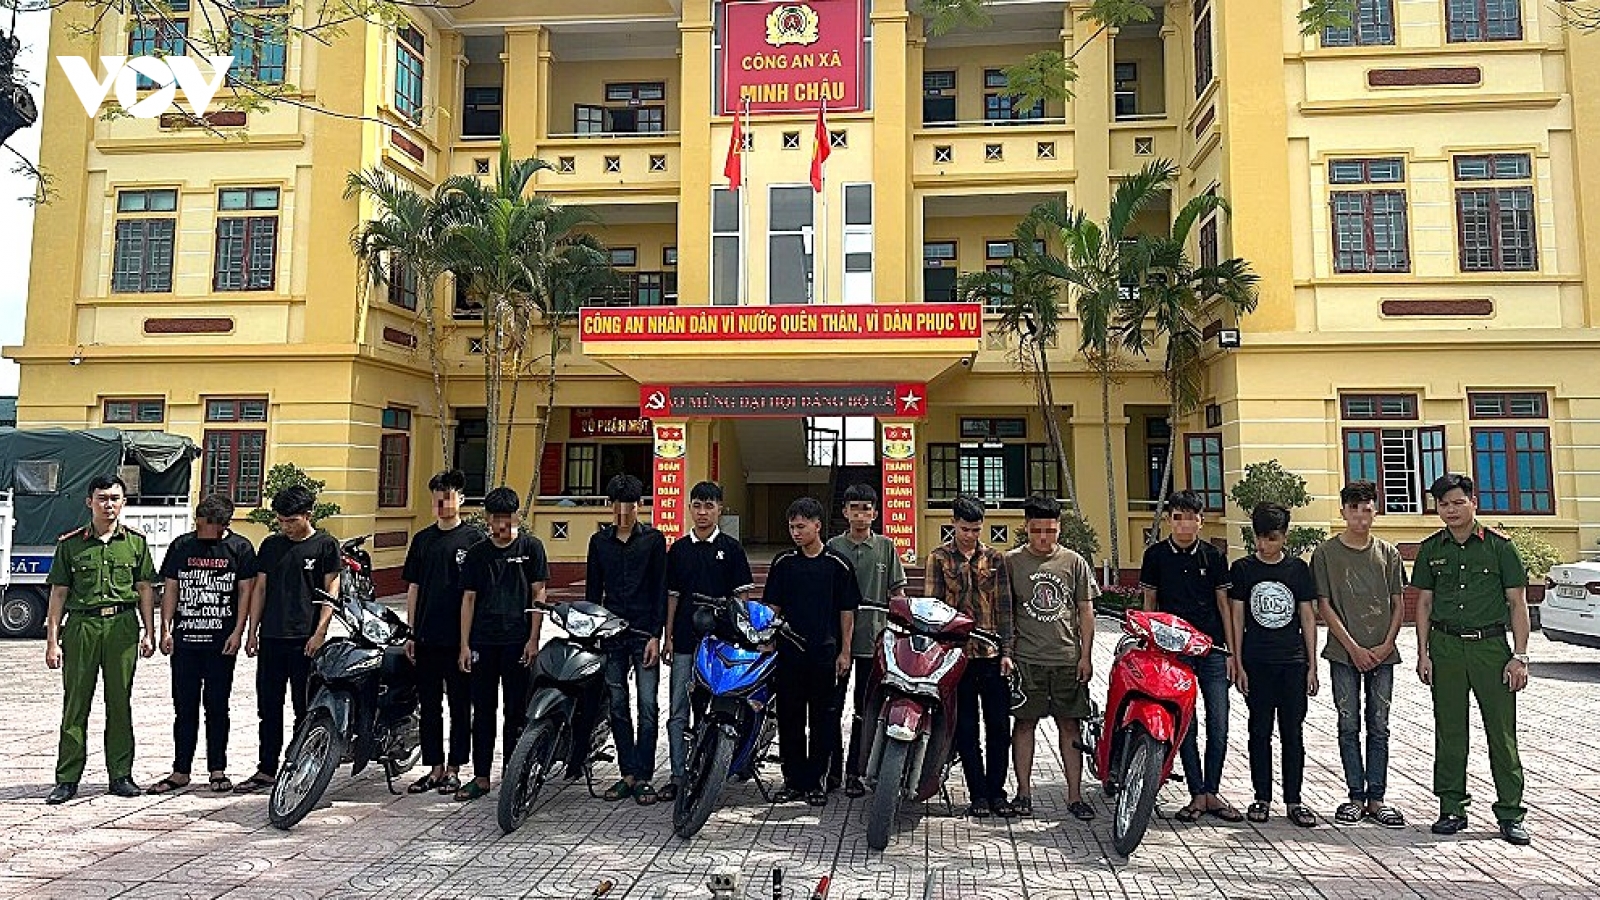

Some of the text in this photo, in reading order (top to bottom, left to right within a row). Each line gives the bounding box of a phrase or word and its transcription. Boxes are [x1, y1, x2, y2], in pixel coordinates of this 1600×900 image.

[741, 49, 842, 70] CÔNG AN XÃ
[740, 78, 845, 103] MINH CHÂU
[584, 309, 977, 335] CÔNG AN NHÂN DÂN VÌ NƯỚC QUÊN THÂN, VÌ DÂN PHỤC VỤ
[885, 461, 913, 471] THÀNH
[887, 473, 911, 484] CÔNG
[885, 486, 913, 496] THÀNH
[887, 499, 911, 509] CÔNG
[885, 523, 913, 534] THÀNH
[891, 537, 911, 547] ÔNG
